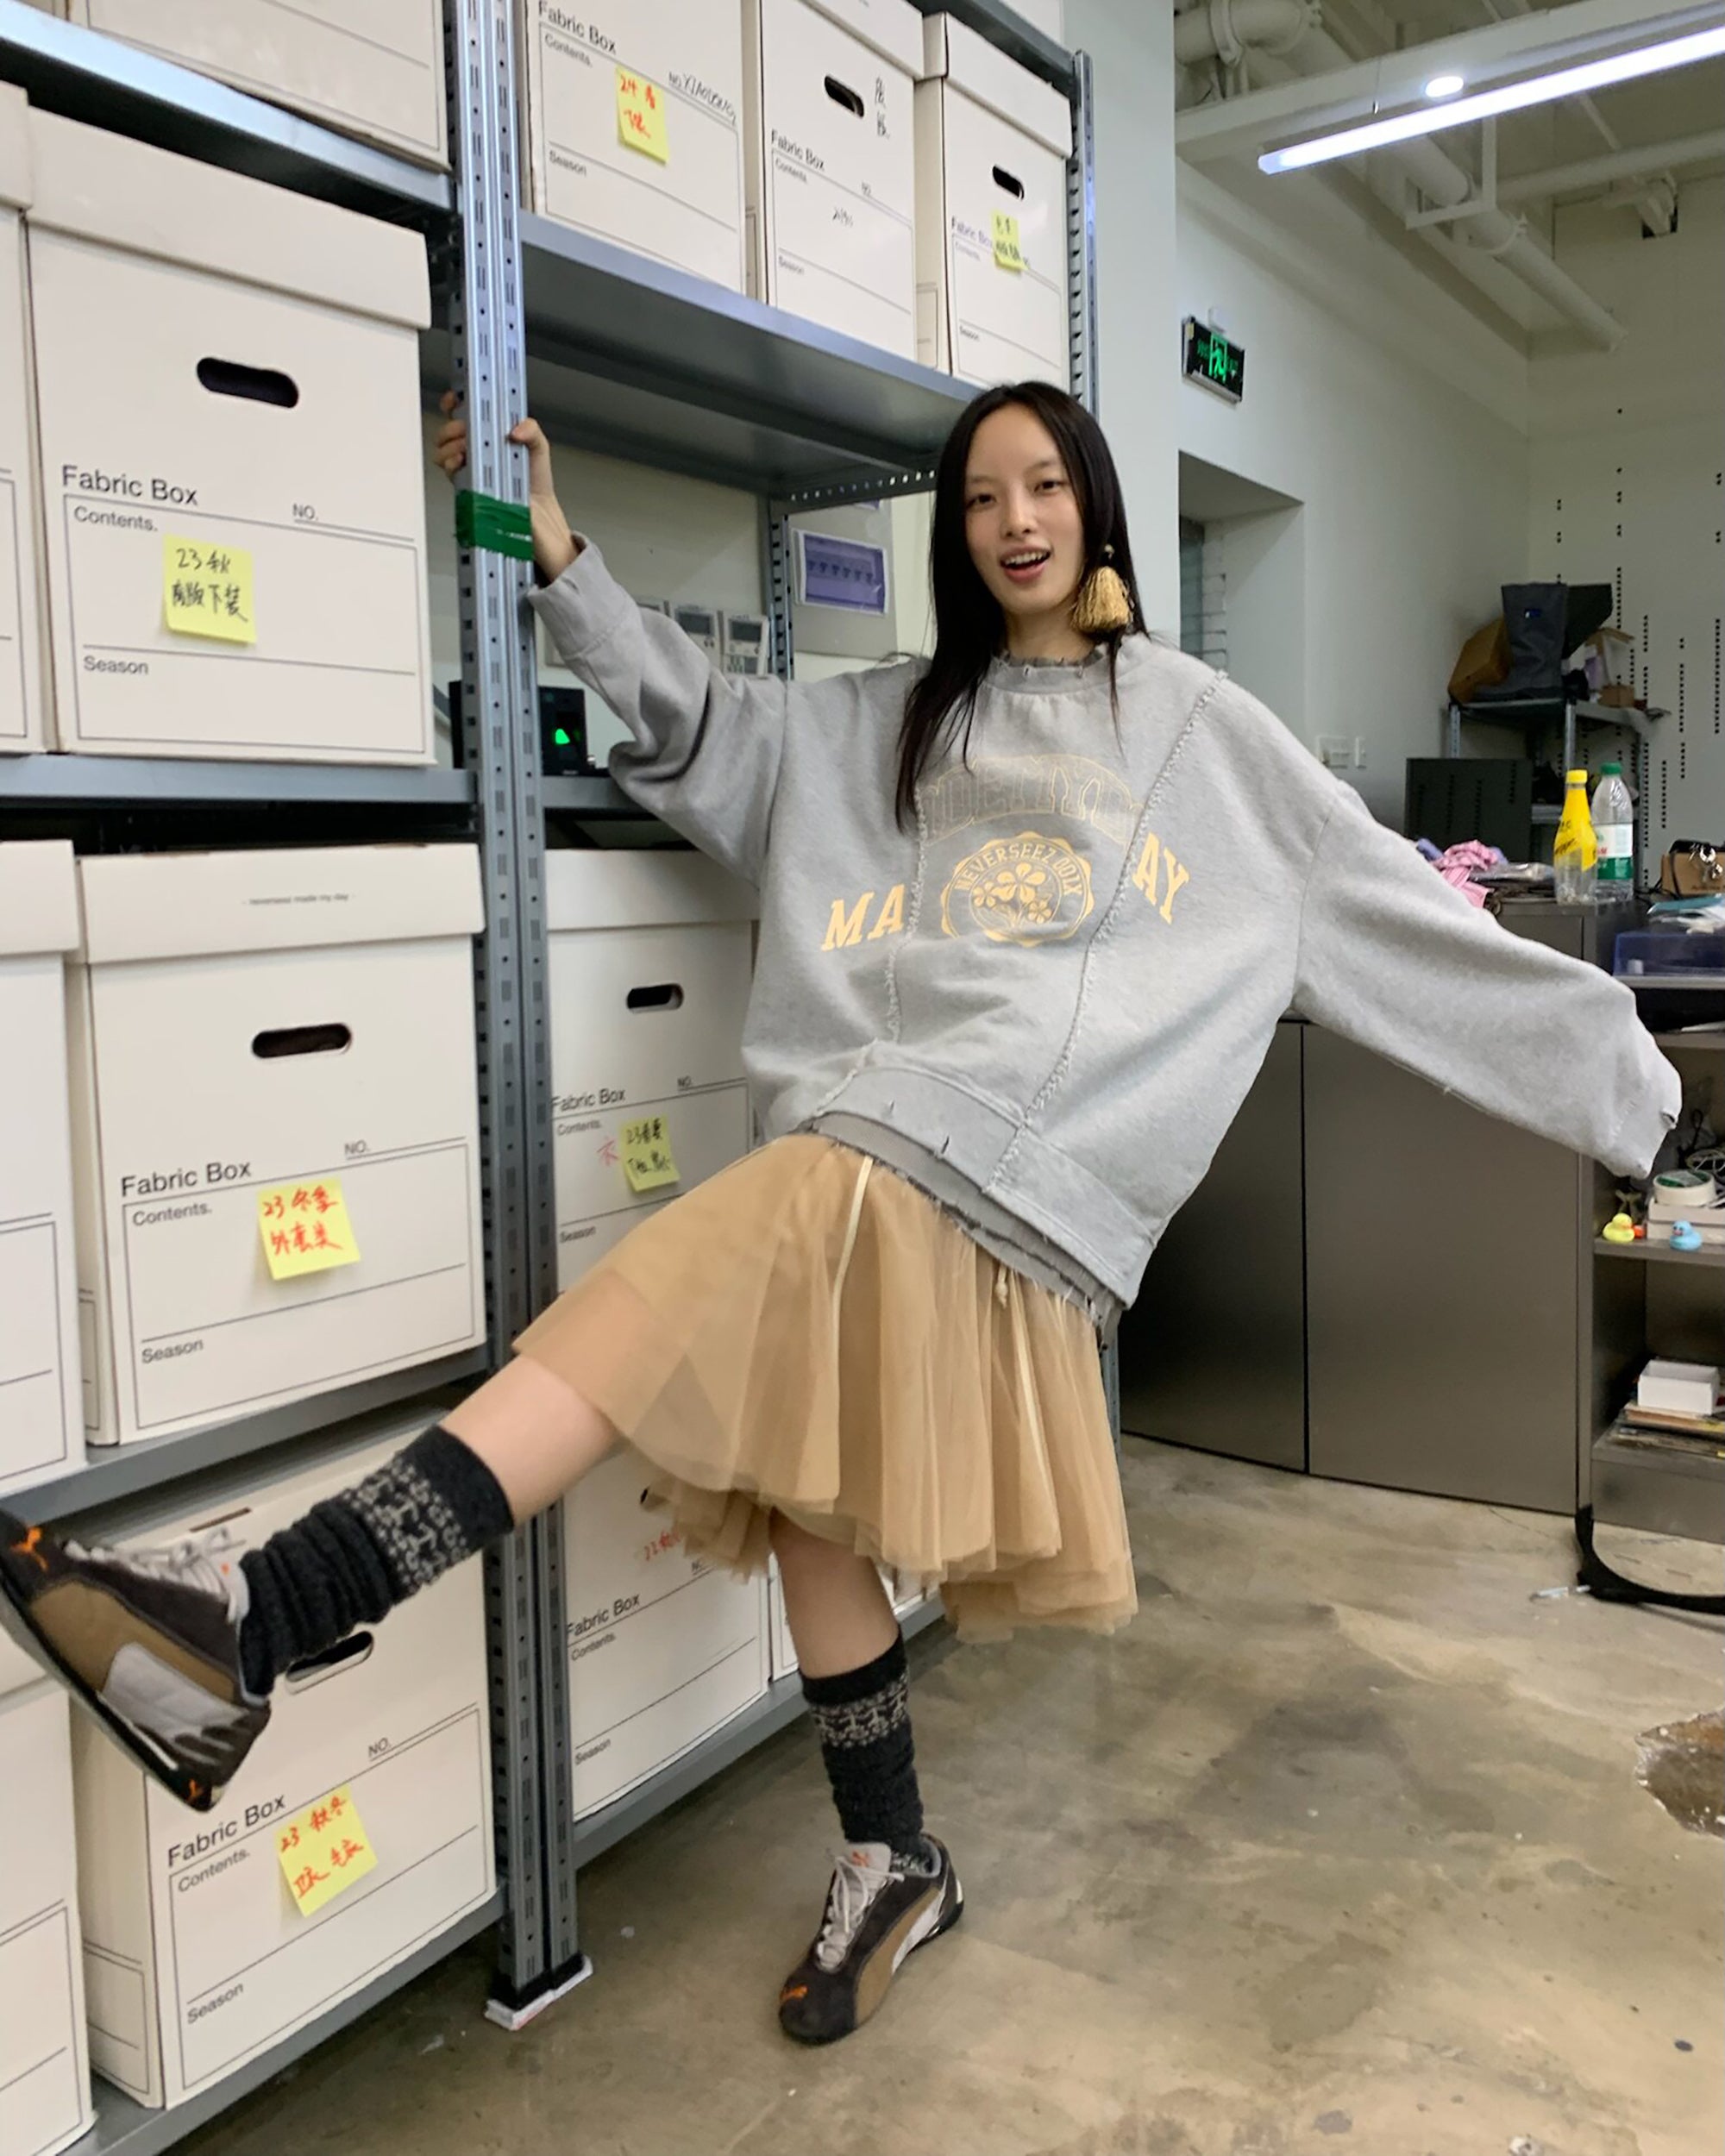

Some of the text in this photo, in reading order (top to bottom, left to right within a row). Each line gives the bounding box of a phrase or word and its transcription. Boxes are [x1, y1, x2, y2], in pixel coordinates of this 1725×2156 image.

[538, 1, 616, 55] Fabric Box
[549, 149, 586, 177] Season
[771, 128, 825, 172] Fabric Box
[62, 465, 198, 506] Fabric Box
[74, 505, 158, 532] Contents.
[293, 504, 318, 521] NO.
[84, 655, 148, 676] Season
[599, 1087, 626, 1105] Box
[345, 1140, 370, 1156] NO.
[121, 1161, 252, 1198] Fabric Box
[132, 1201, 212, 1227] Contents.
[561, 1225, 597, 1244] Season
[141, 1338, 204, 1364] Season
[613, 1594, 641, 1618] Box
[367, 1737, 392, 1758] NO.
[574, 1737, 612, 1765] Season
[167, 1795, 287, 1868] Fabric Box
[177, 1847, 251, 1893] Contents.
[187, 1983, 245, 2025] Season
